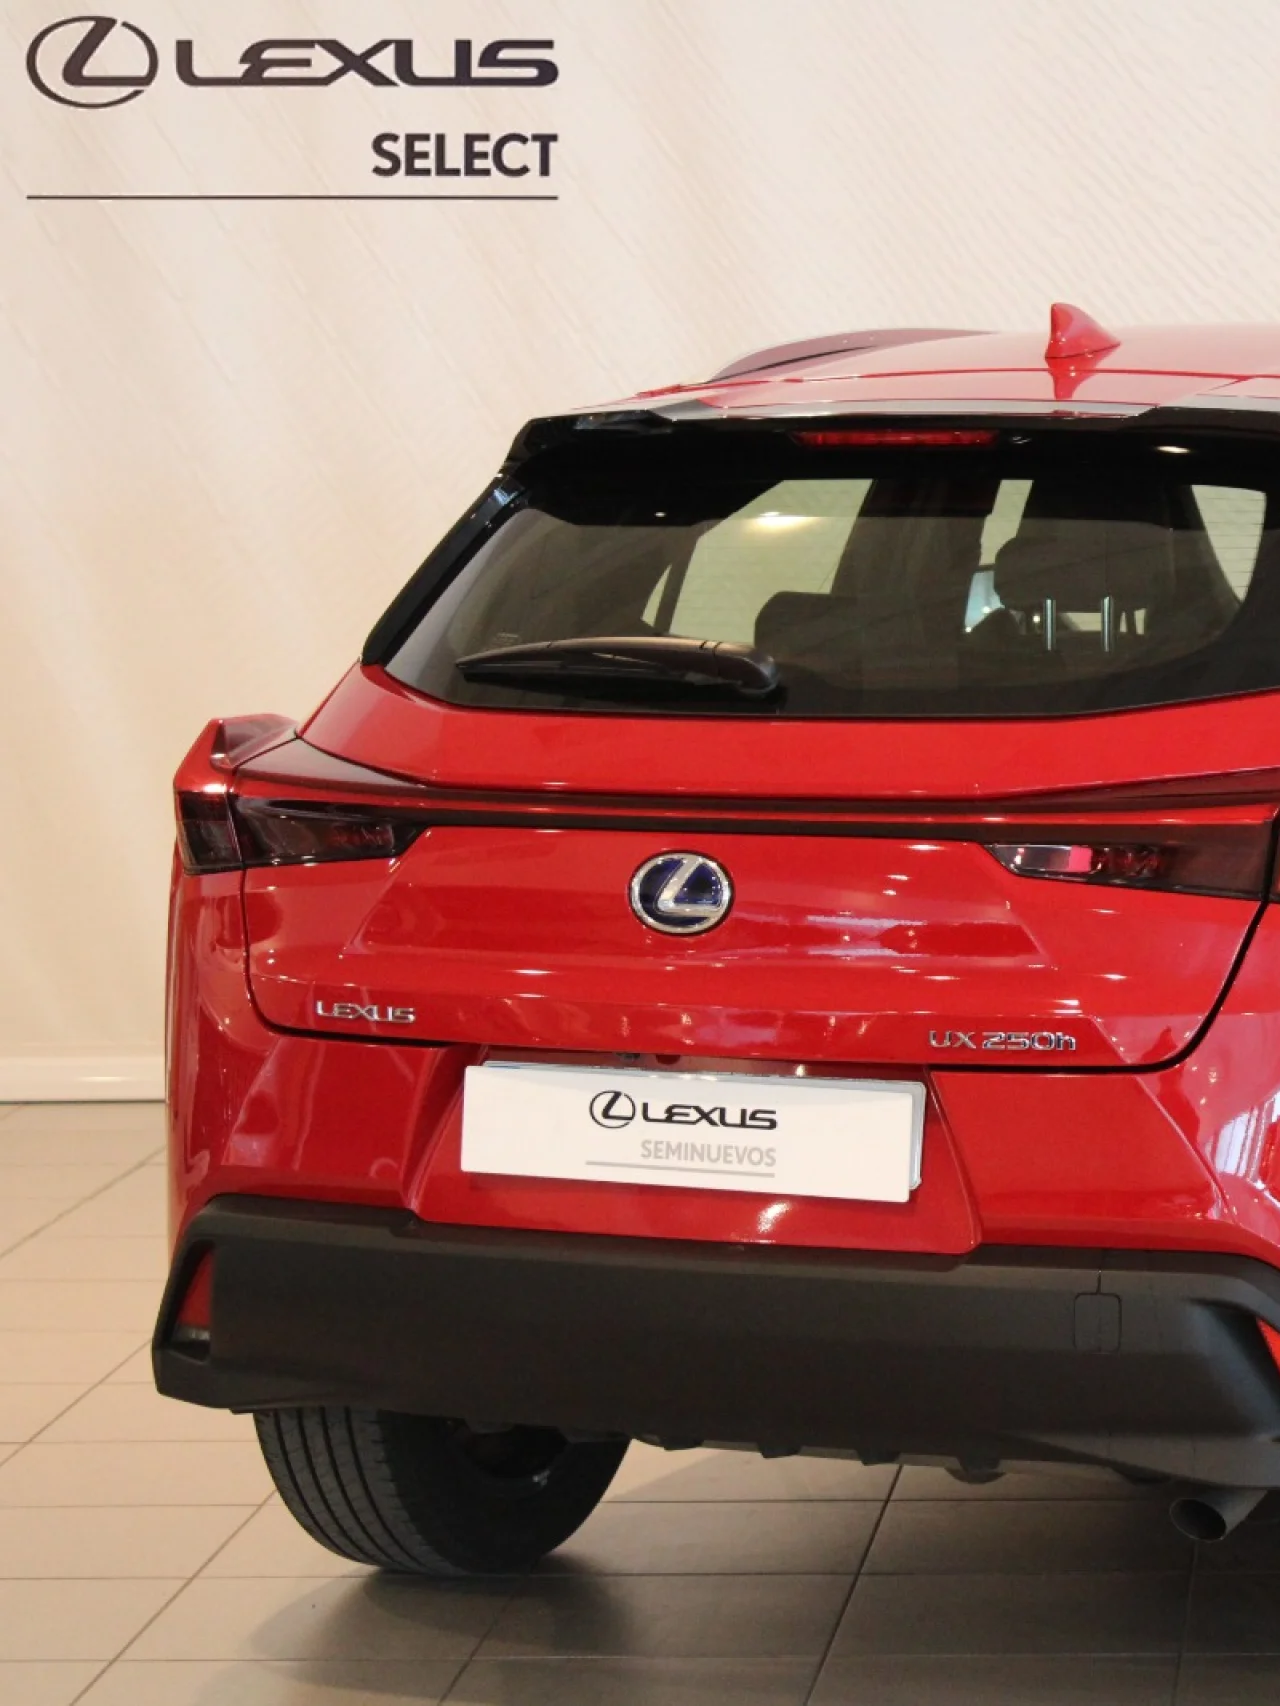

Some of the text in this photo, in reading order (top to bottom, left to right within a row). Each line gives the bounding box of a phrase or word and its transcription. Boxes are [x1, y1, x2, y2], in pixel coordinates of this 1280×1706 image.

[175, 38, 560, 88] LEXUS
[370, 132, 560, 179] SELECT
[316, 1000, 416, 1024] LEXUS
[928, 1030, 1077, 1051] UX 250h
[641, 1102, 778, 1131] LEXUS
[640, 1140, 777, 1168] SEMINUEVOS
